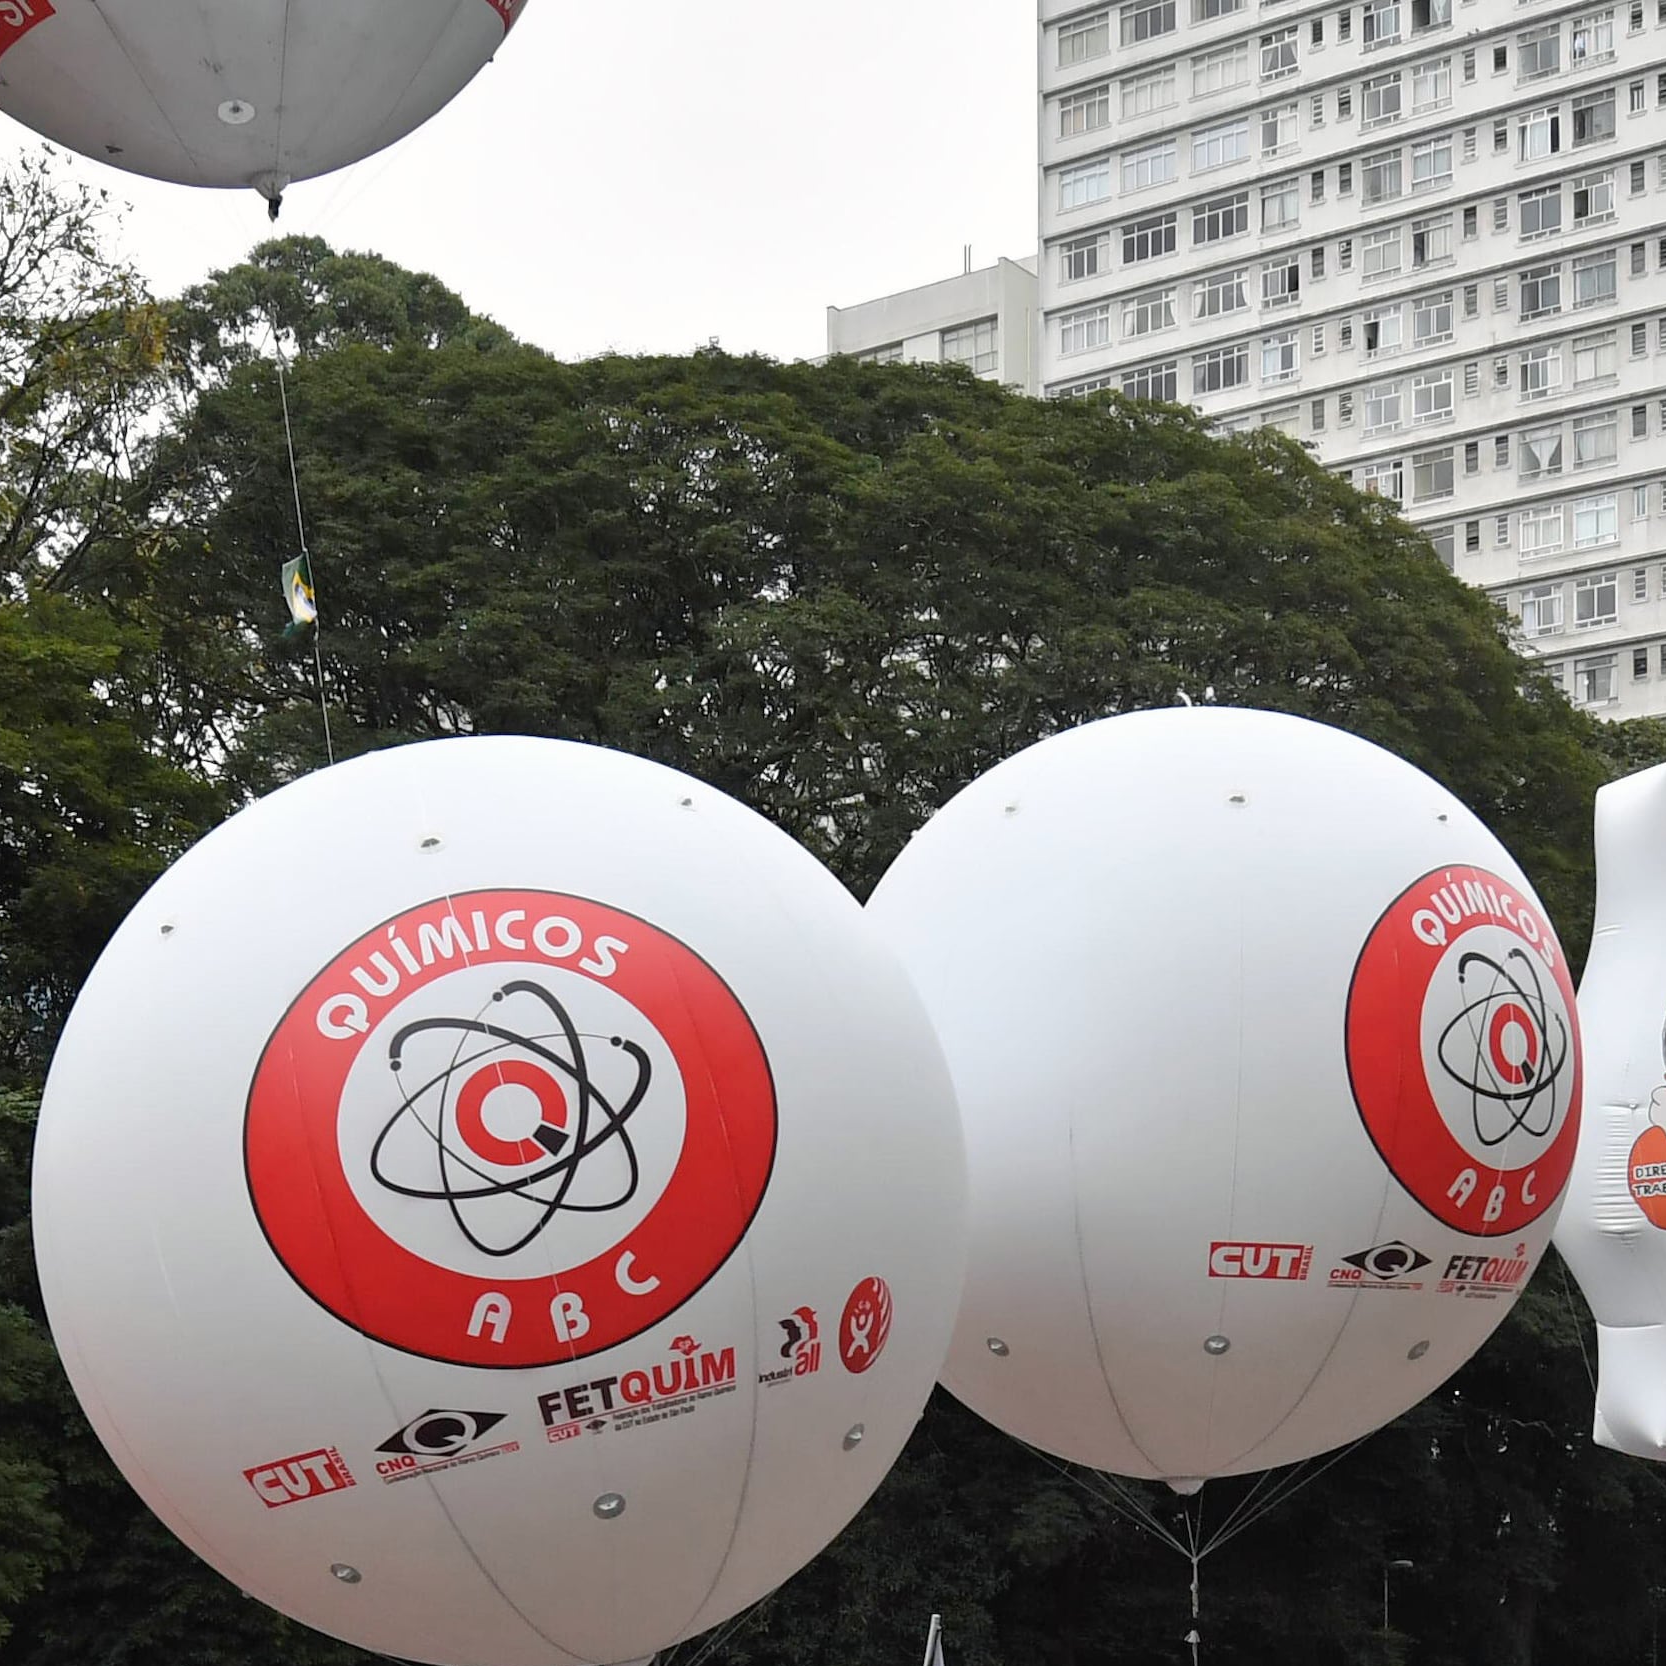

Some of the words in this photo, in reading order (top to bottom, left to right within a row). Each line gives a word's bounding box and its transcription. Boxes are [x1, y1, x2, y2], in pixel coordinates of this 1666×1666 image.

[1411, 872, 1557, 968] QUÍMICOS
[316, 909, 629, 1041] QUÍMICOS
[1210, 1244, 1301, 1278] CUT
[1300, 1245, 1314, 1280] BRASIL
[1329, 1269, 1362, 1280] CNQ
[1442, 1255, 1529, 1284] FETQUIM
[537, 1346, 736, 1426] FETQUIM
[549, 1428, 578, 1442] CUT
[252, 1455, 337, 1504] CUT
[328, 1446, 357, 1487] BRASIL
[375, 1455, 417, 1476] CNQ
